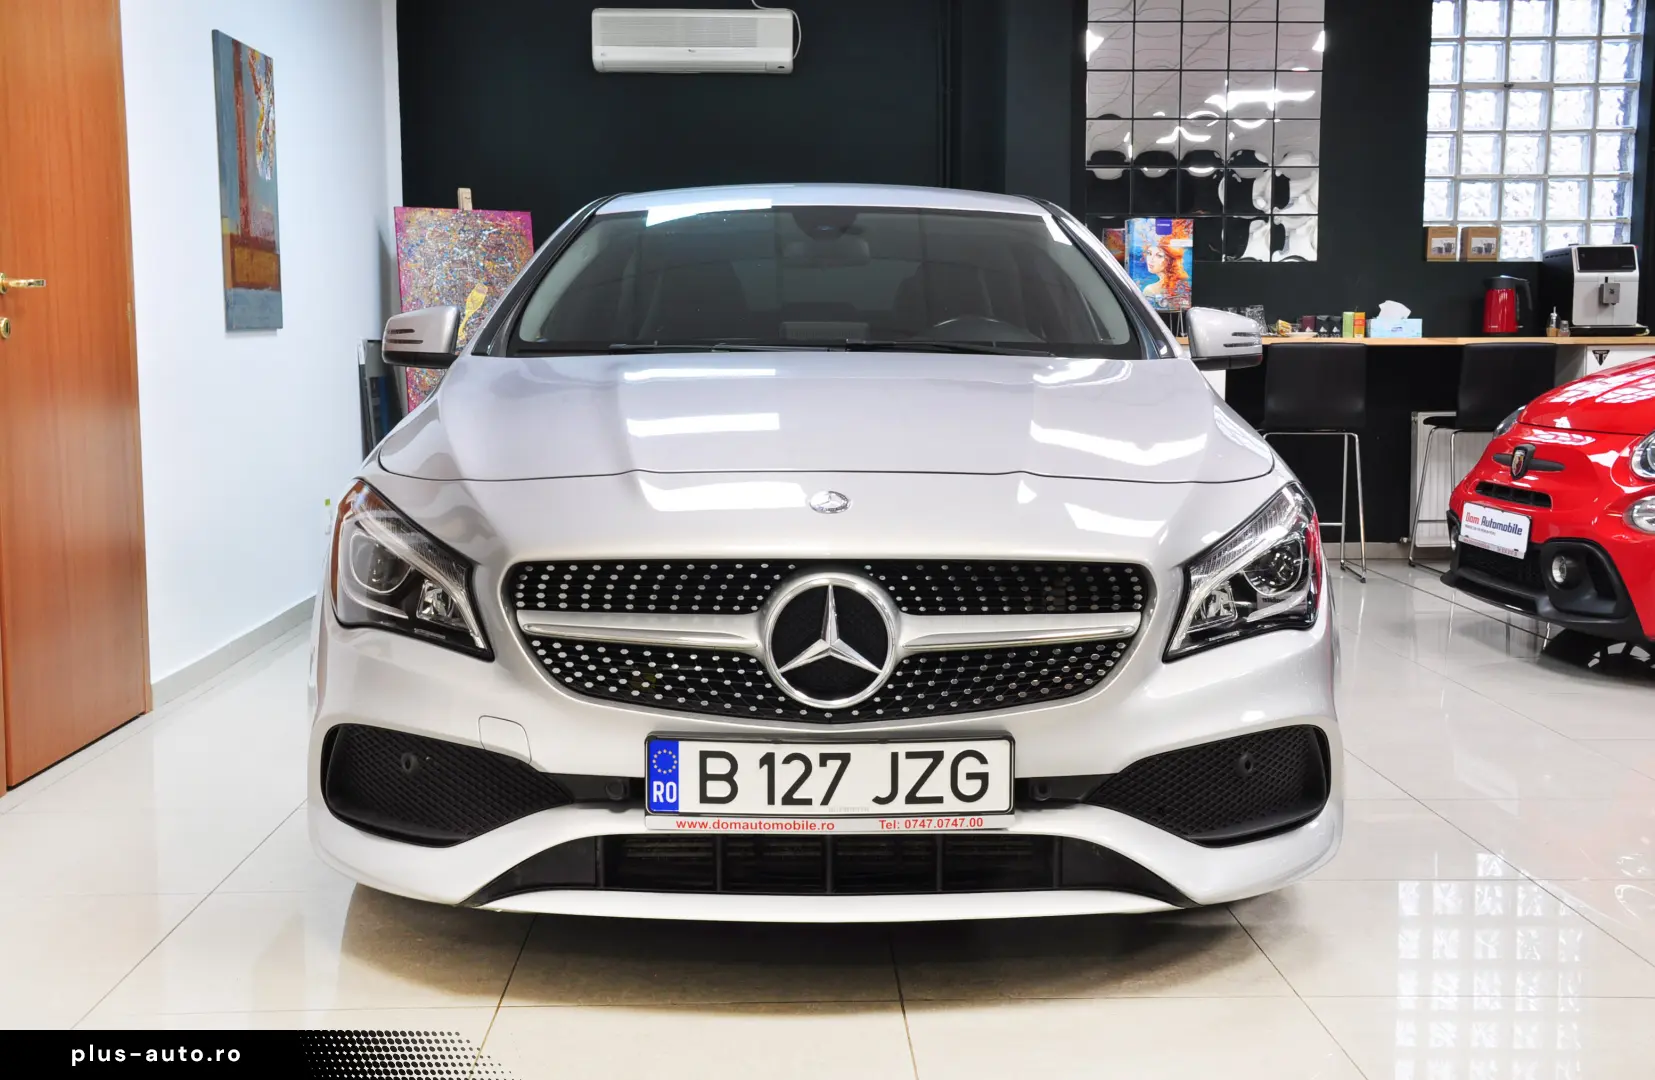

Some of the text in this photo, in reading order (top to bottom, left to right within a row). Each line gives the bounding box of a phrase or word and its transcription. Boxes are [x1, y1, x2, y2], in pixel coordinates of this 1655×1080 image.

[1481, 516, 1523, 536] Automobile
[699, 749, 989, 805] B 127 JZG
[652, 781, 677, 803] RO
[676, 817, 984, 831] www.domautomobile.ro Tel: 0747.0747.00
